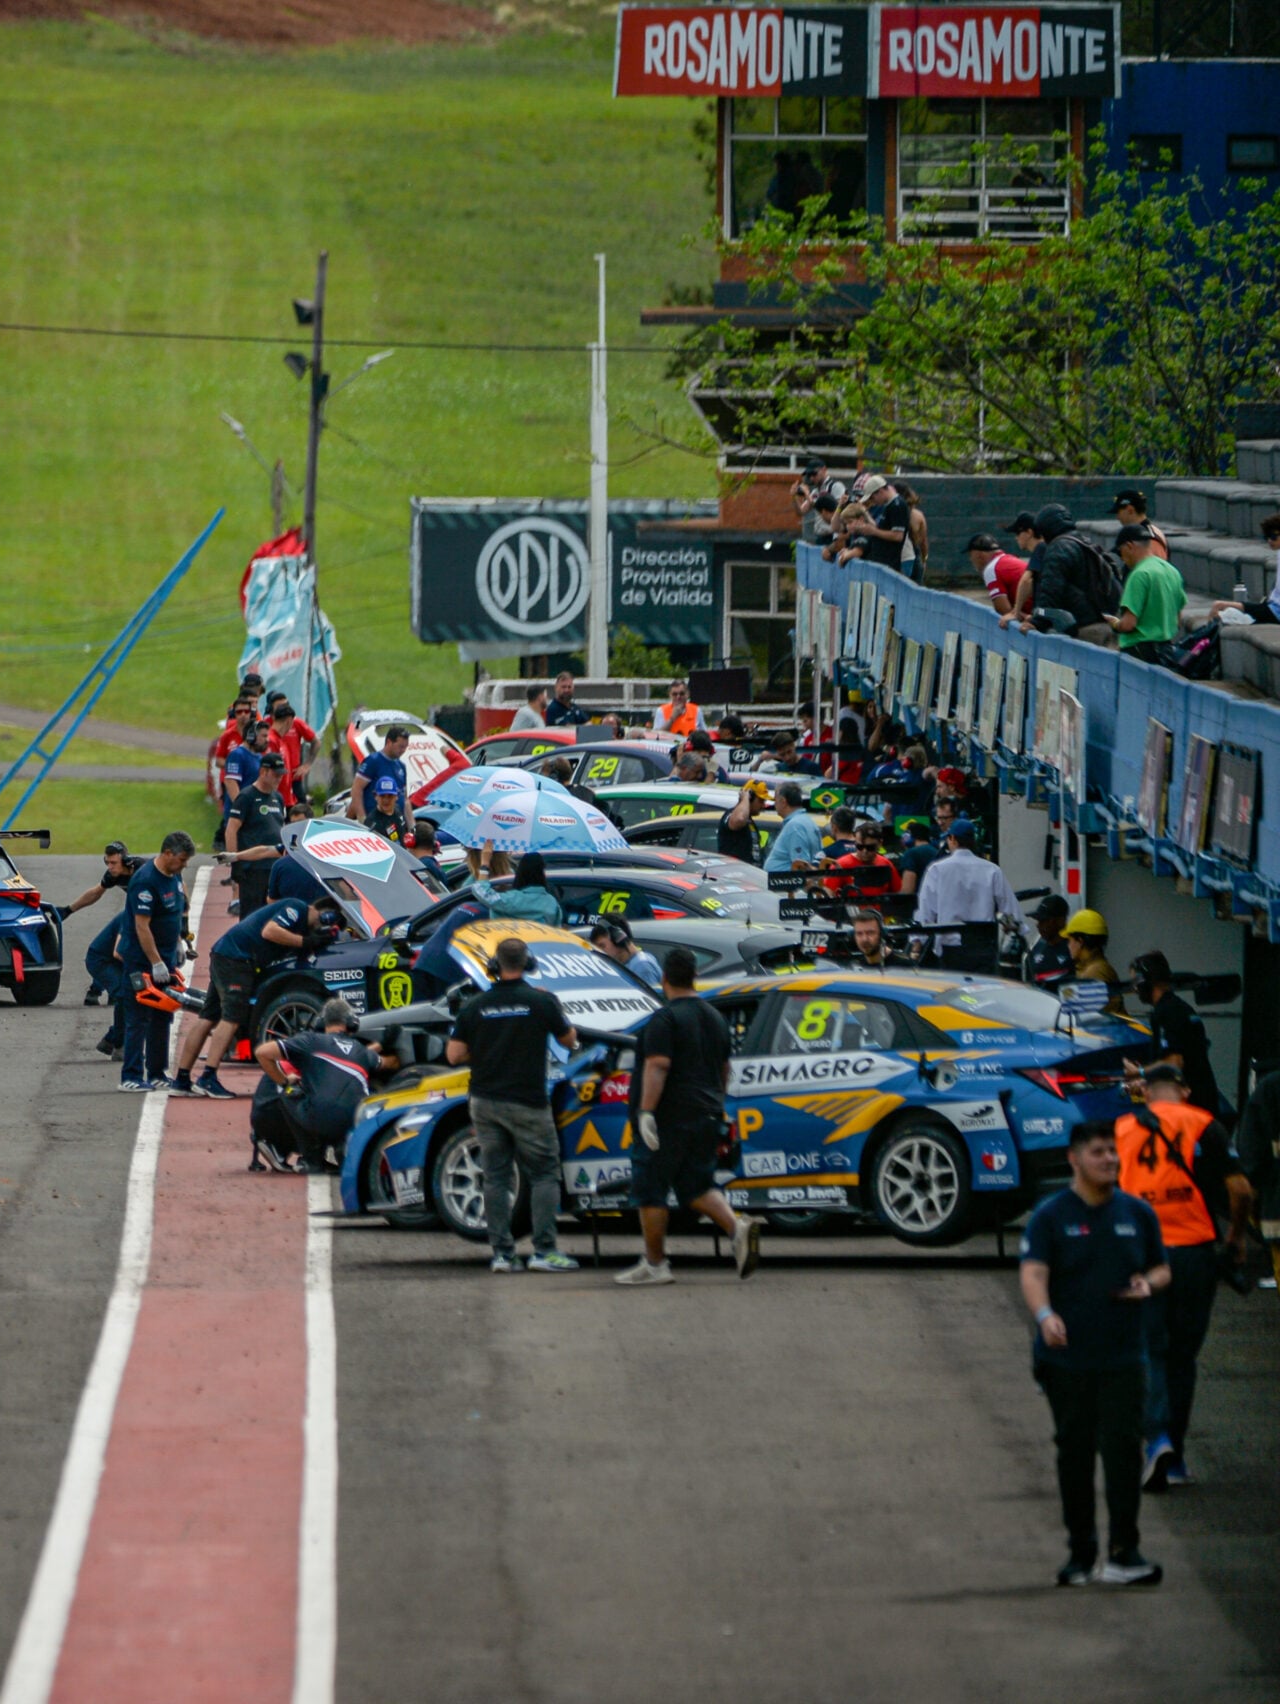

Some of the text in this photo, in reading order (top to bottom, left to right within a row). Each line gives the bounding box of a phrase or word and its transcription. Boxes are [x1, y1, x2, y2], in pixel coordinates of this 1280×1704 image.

[644, 14, 844, 89] ROSAMONTE
[889, 16, 1107, 86] ROSAMONTE
[621, 546, 708, 567] Dirección
[621, 567, 709, 587] Provincial
[620, 586, 714, 607] de Vialida
[588, 757, 619, 779] 29
[491, 814, 527, 825] PALADINI
[538, 816, 577, 825] PALADINI
[308, 835, 391, 858] PALADINI
[598, 891, 631, 915] 16
[377, 951, 400, 970] 16
[323, 969, 364, 982] SEIKO
[796, 1000, 833, 1041] 8
[739, 1057, 876, 1086] SIMAGRO
[578, 1081, 597, 1102] 8
[747, 1152, 821, 1175] CAR ONE
